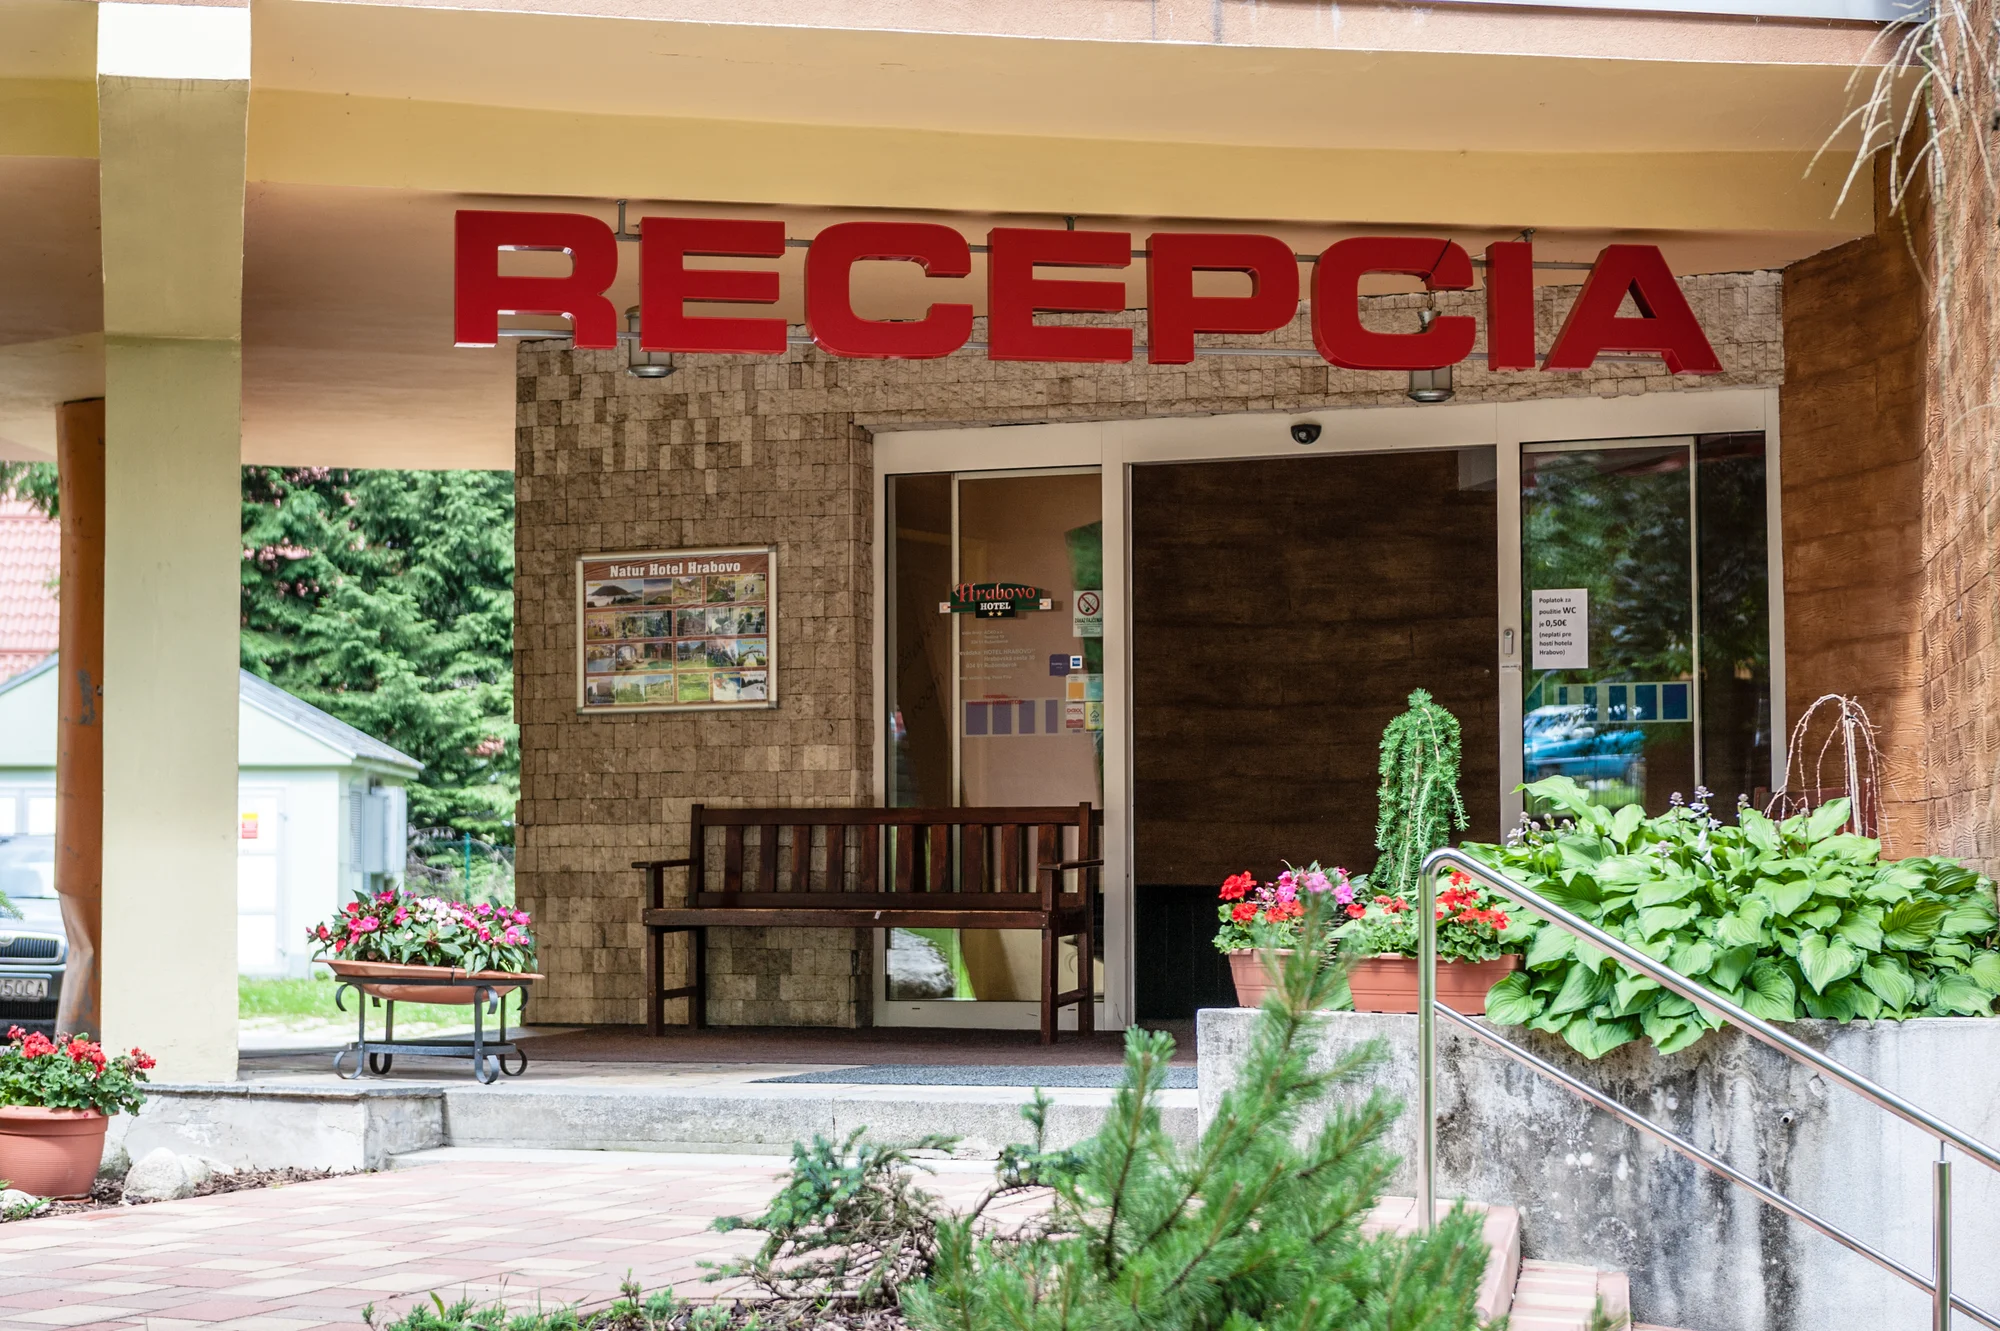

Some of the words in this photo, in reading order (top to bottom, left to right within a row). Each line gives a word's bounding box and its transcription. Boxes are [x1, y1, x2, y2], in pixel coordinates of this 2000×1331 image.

[454, 210, 1724, 375] RECEPCIA
[610, 565, 645, 577] Natur
[650, 563, 683, 575] Hotel
[688, 561, 741, 574] Hrabovo
[953, 582, 1036, 602] Hrabovo
[980, 602, 1011, 610] HOTEL
[1545, 619, 1567, 627] 0,50€
[0, 980, 46, 998] 50CA
